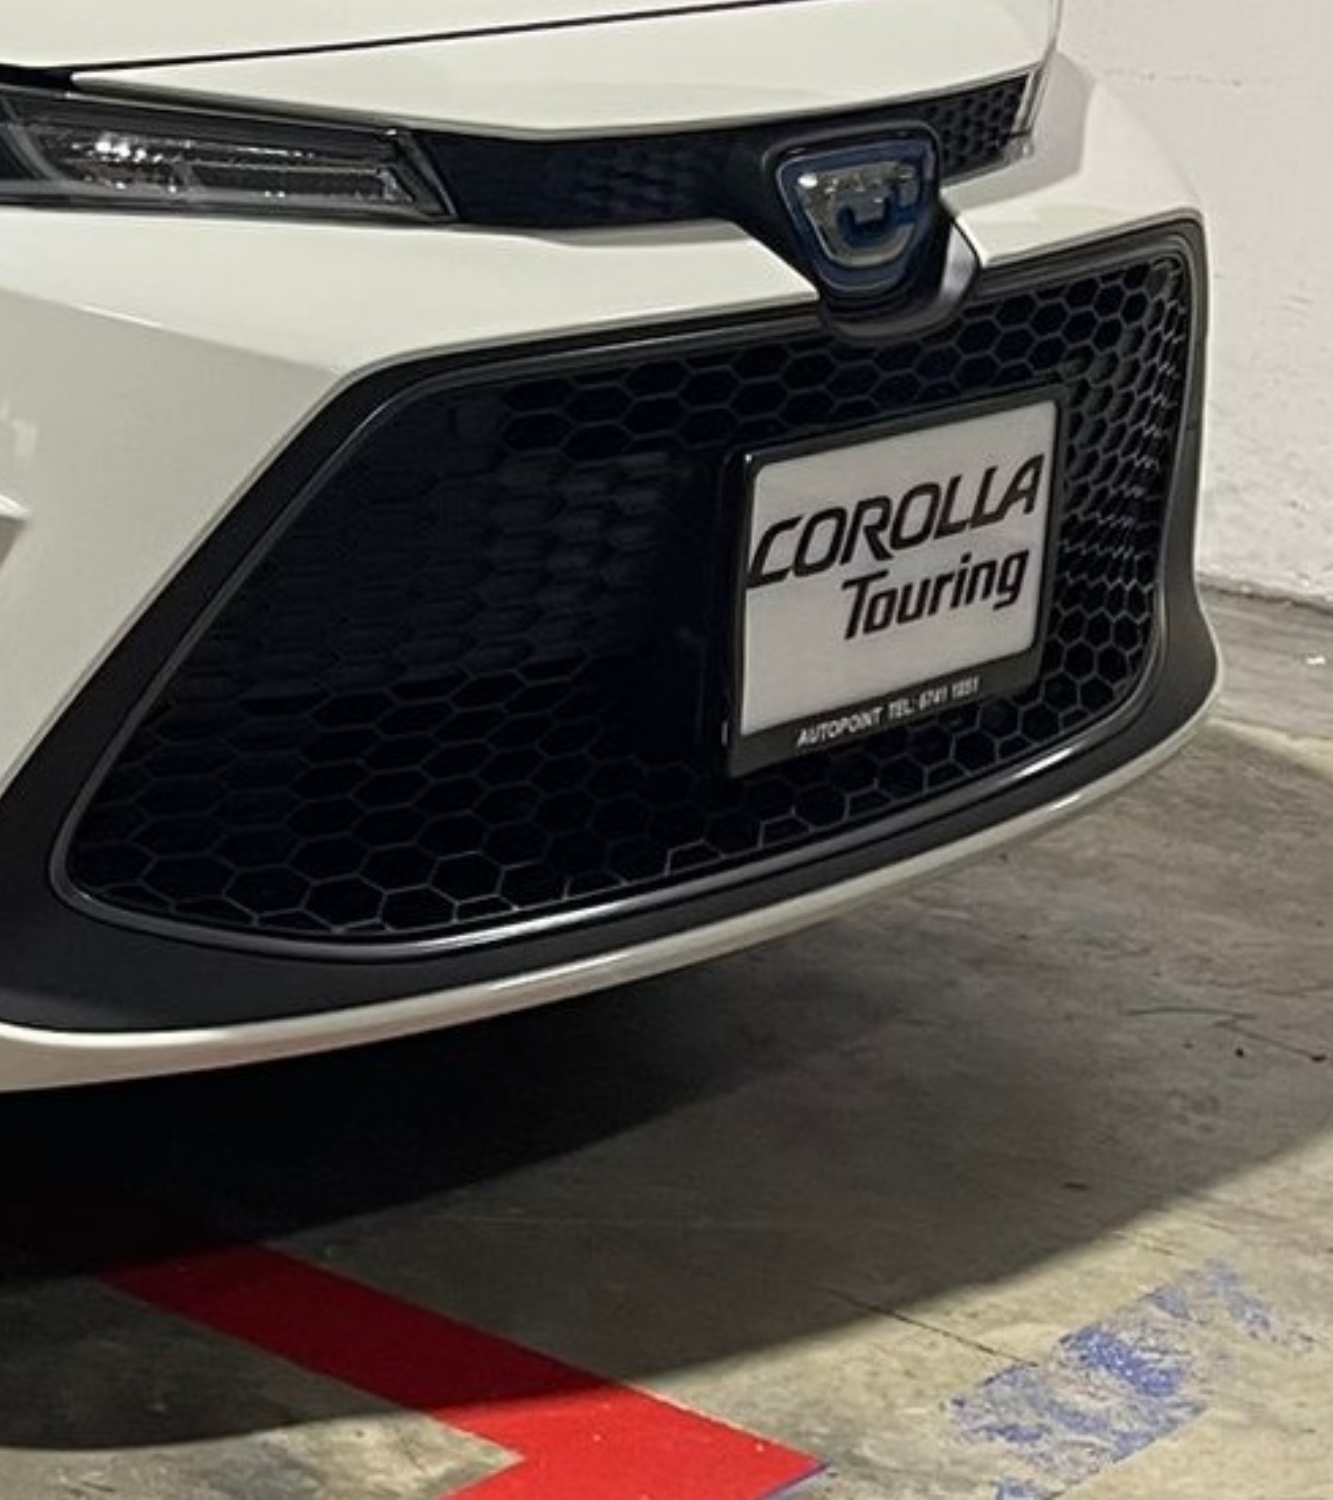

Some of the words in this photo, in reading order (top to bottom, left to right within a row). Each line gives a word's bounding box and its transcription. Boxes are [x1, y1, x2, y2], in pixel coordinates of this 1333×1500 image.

[745, 453, 1045, 588] COROLLA
[841, 549, 1030, 640] Touring
[797, 706, 883, 747] AUTOPOINT
